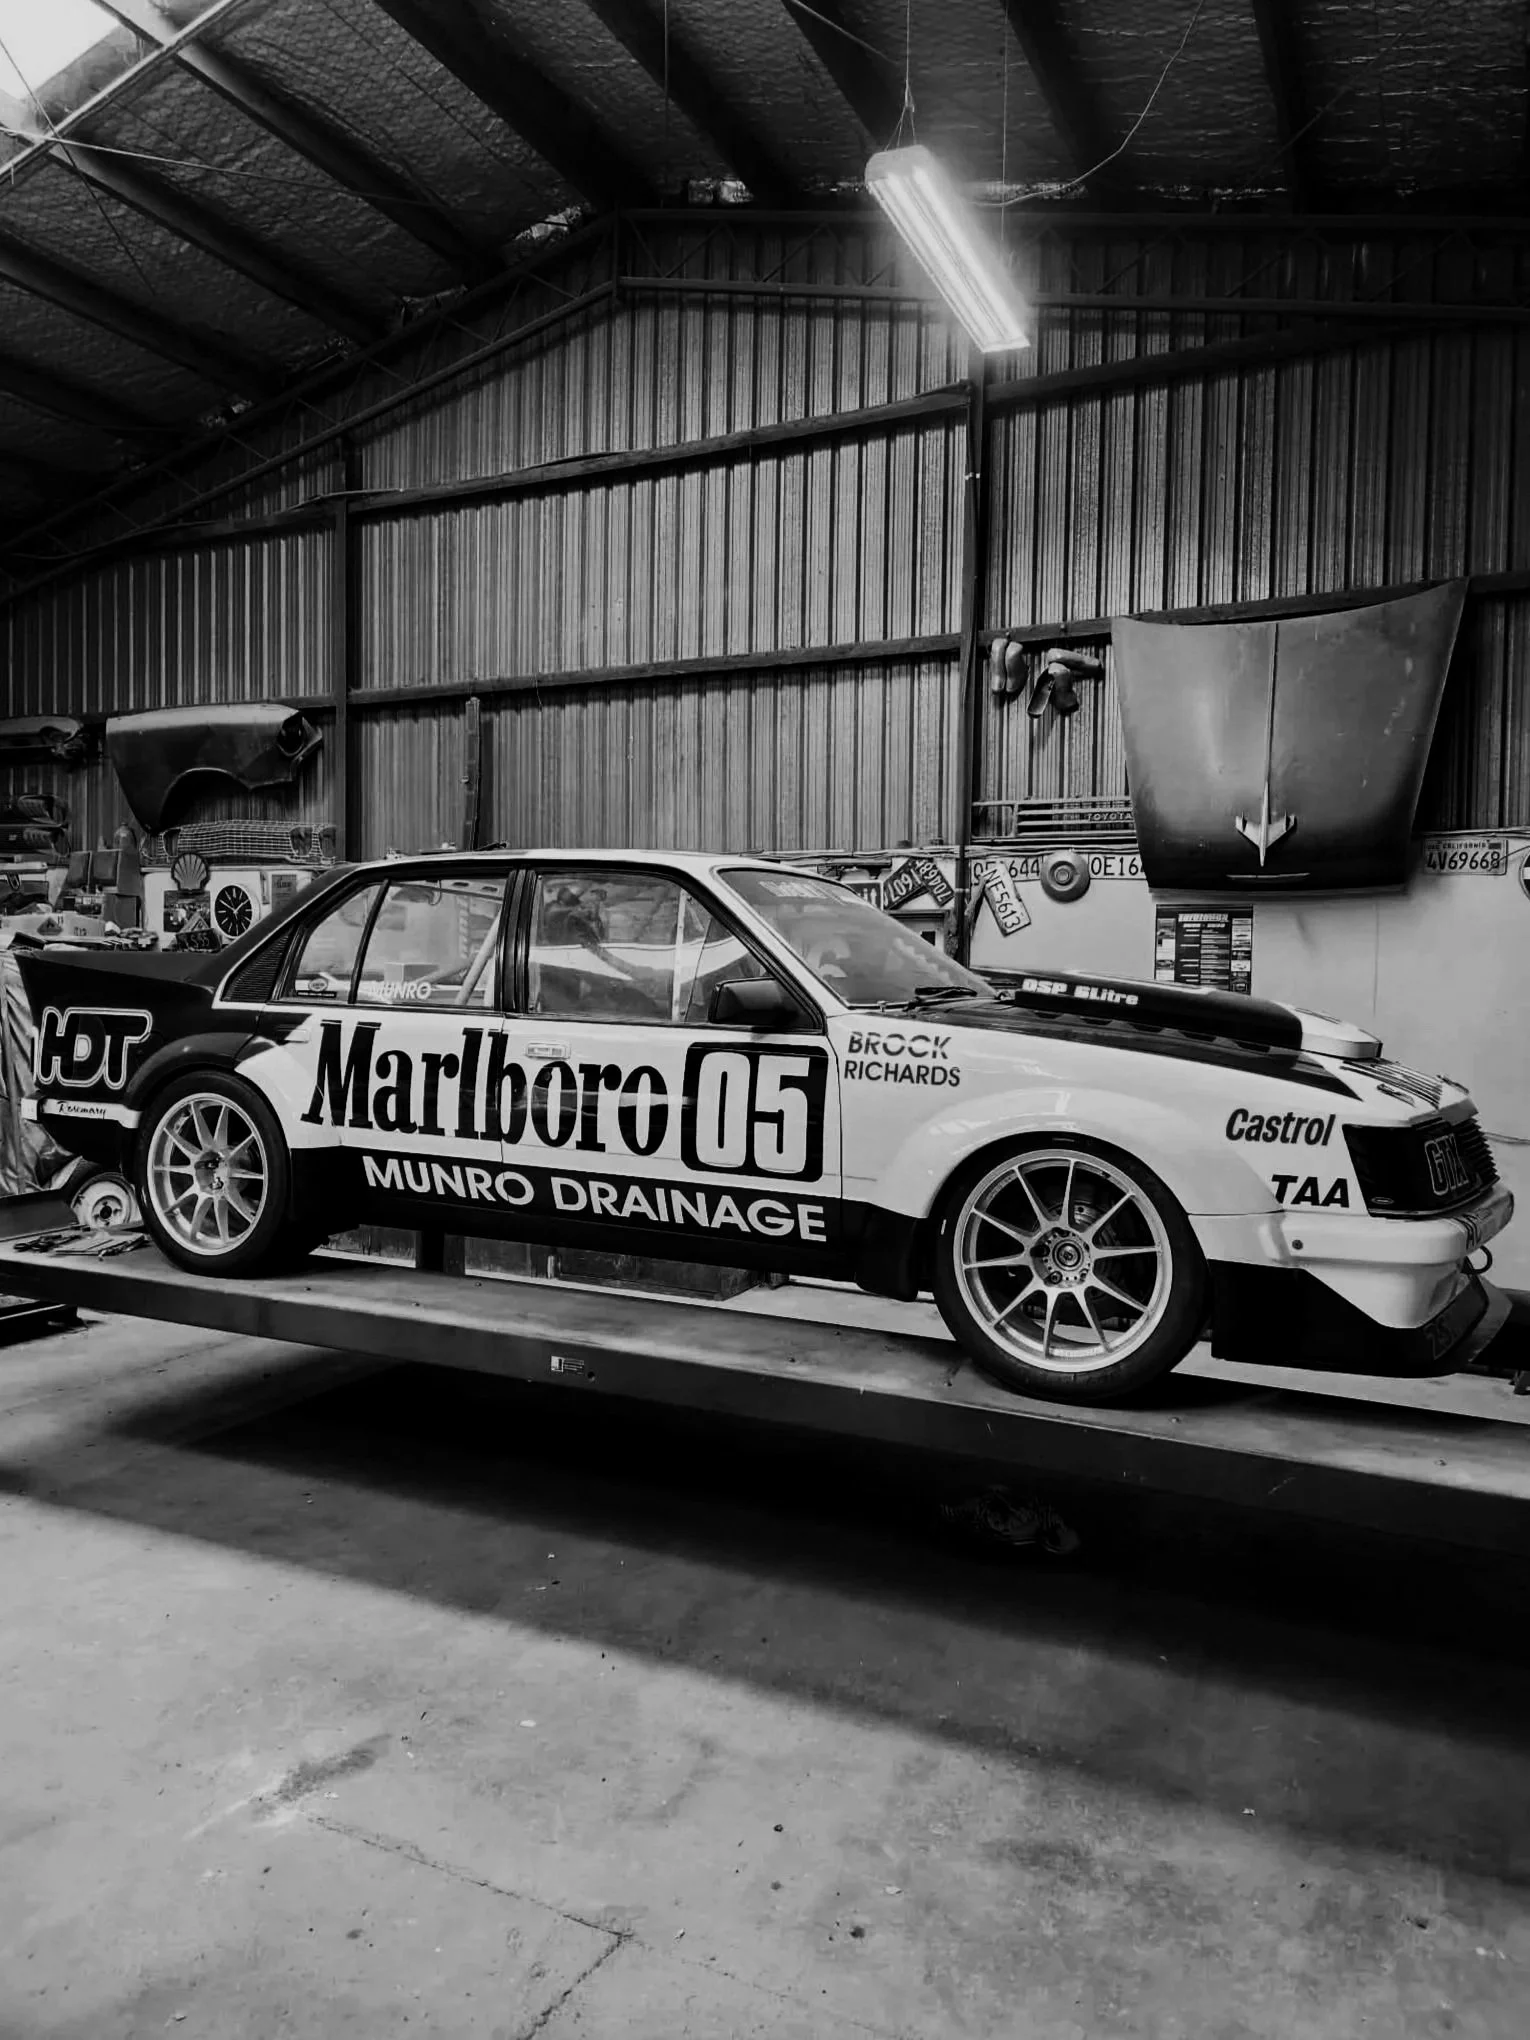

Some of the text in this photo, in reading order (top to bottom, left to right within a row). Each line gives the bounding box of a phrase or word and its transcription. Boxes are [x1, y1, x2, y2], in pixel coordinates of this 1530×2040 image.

[1087, 812, 1133, 822] TOYOTA
[1426, 851, 1501, 871] 4V69668
[37, 1006, 153, 1090] HDT
[847, 1031, 952, 1060] BROCK
[843, 1059, 961, 1087] RICHARDS
[300, 1020, 811, 1174] Marlboro 05
[1225, 1107, 1337, 1146] Castrol
[1423, 1133, 1471, 1197] GTX
[362, 1156, 828, 1242] MUNRO DRAINAGE
[1271, 1174, 1350, 1208] TAA
